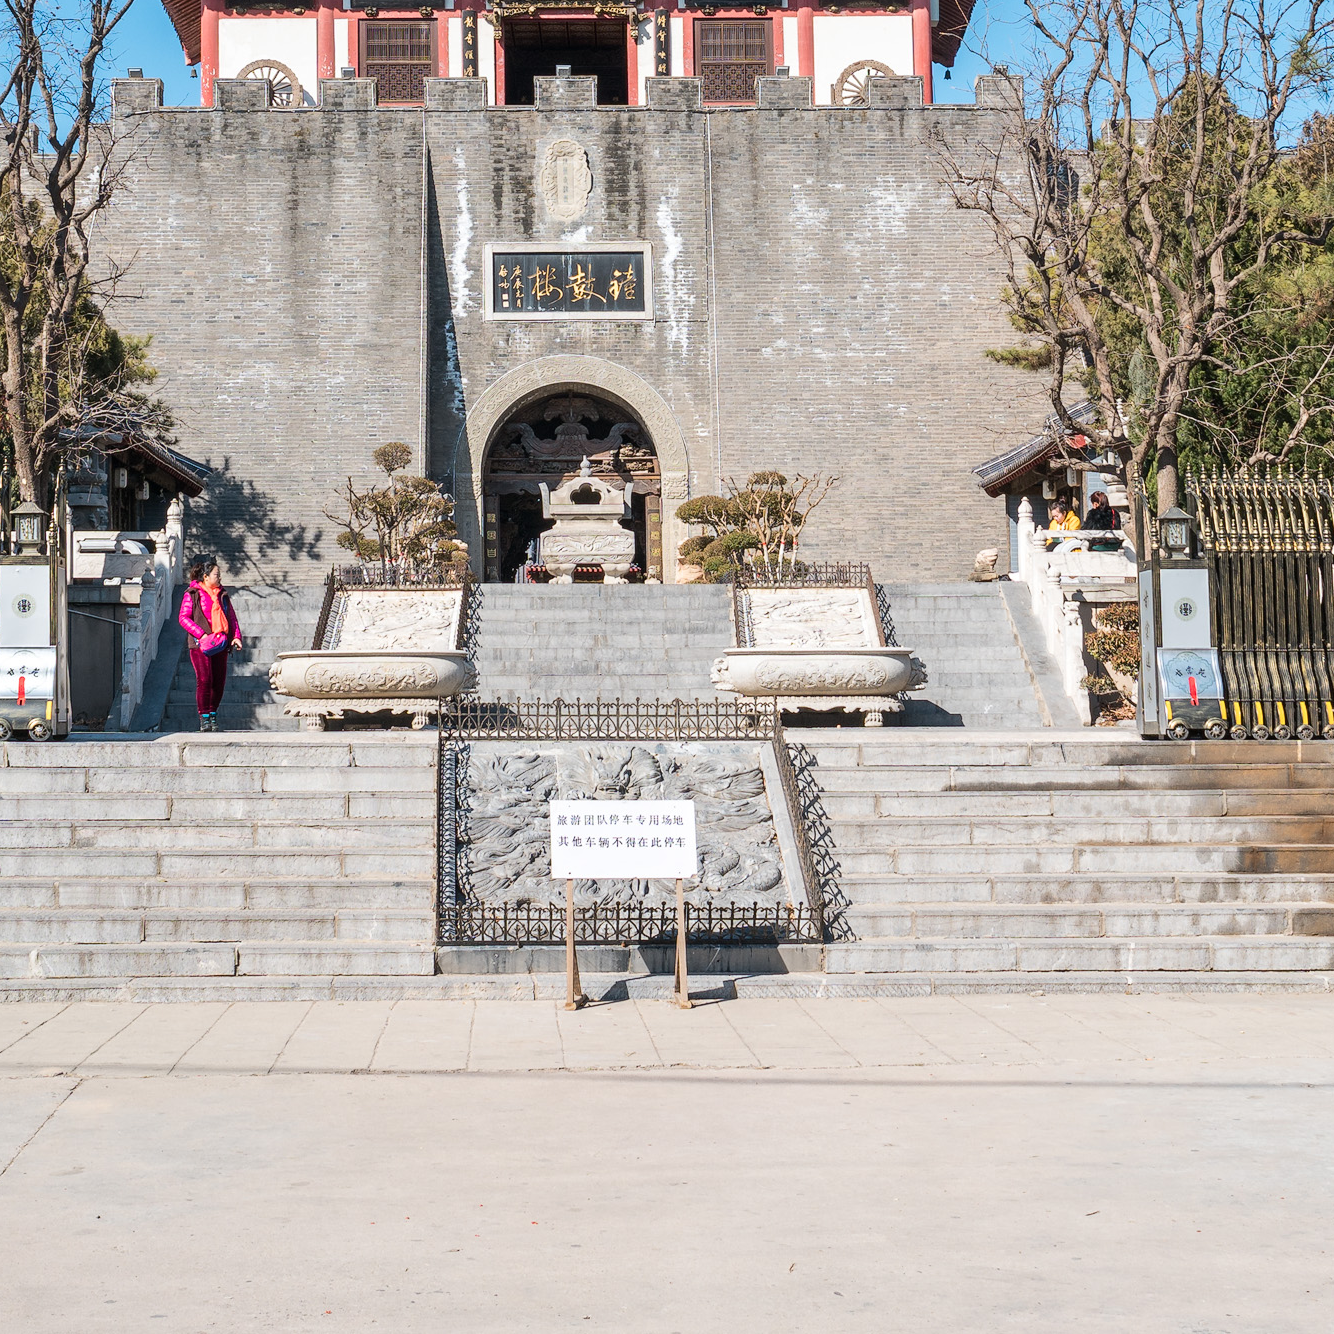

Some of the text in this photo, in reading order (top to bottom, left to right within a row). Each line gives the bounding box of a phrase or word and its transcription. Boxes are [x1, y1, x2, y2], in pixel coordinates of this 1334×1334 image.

[557, 814, 684, 826] 旅游团队停车专用场地
[557, 835, 686, 848] 其他车辆不得在此停车
